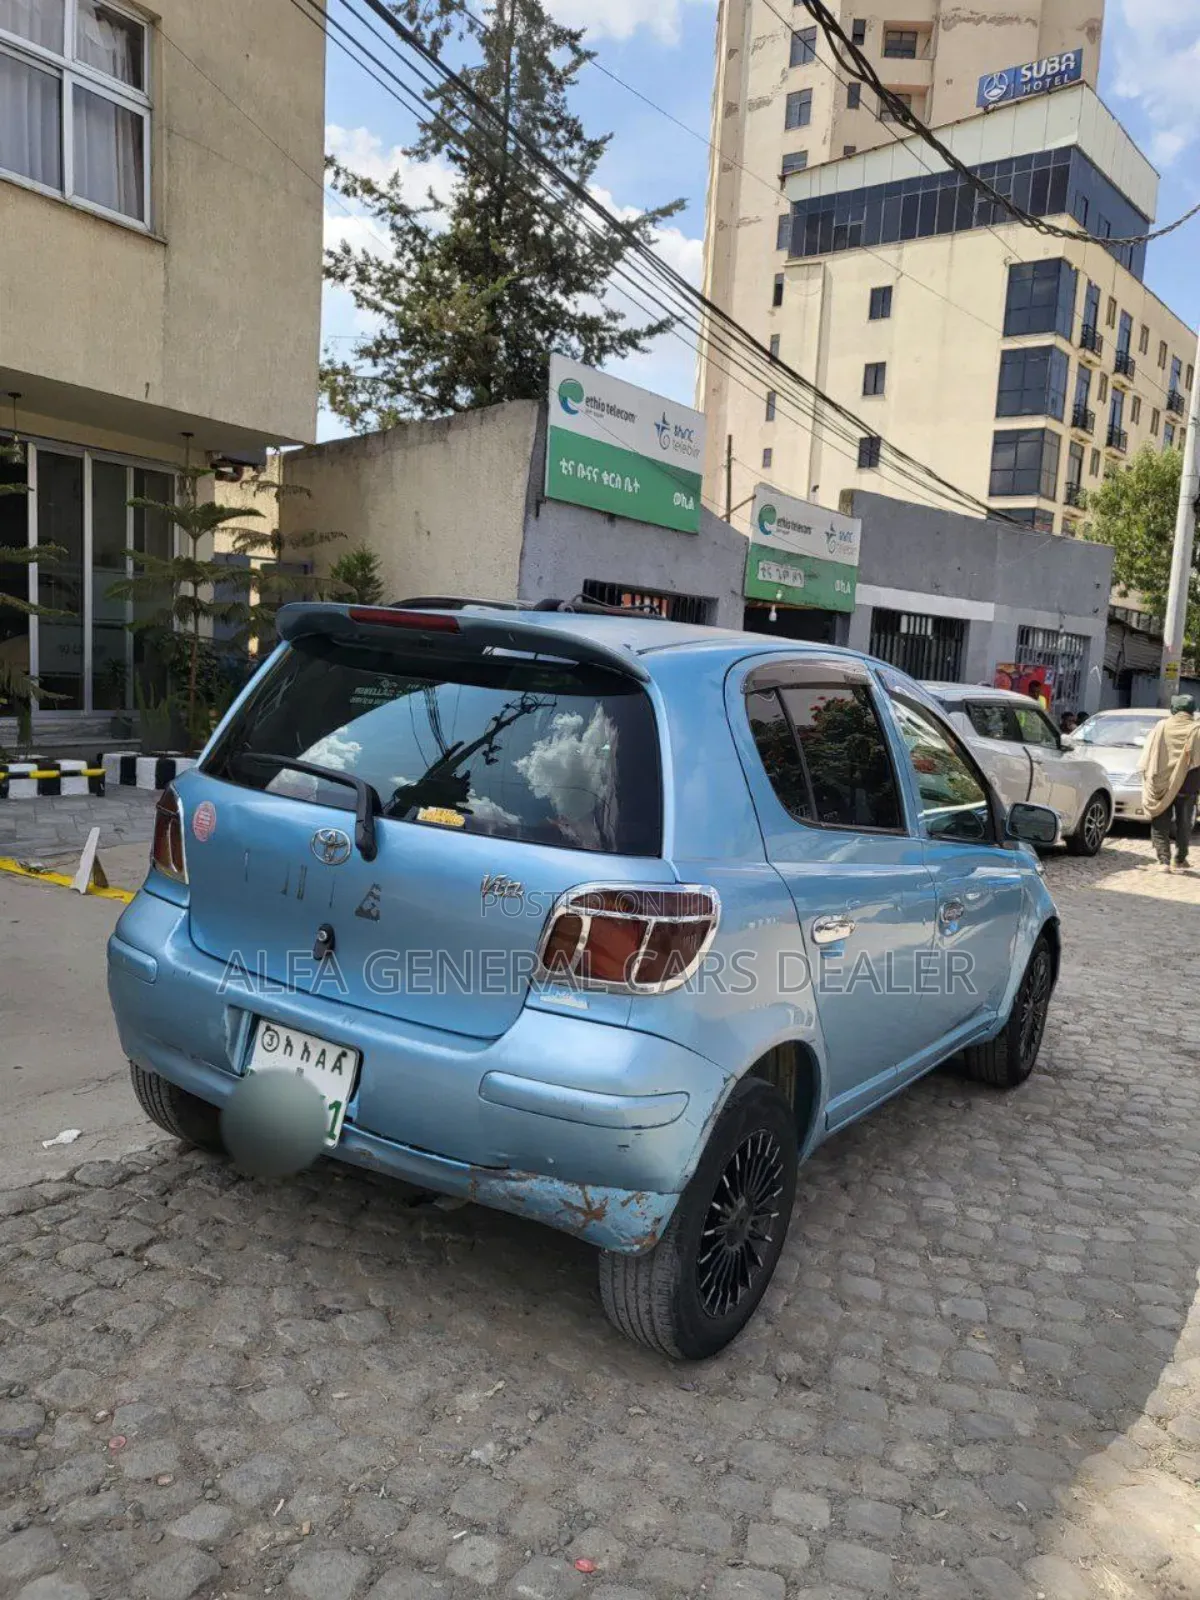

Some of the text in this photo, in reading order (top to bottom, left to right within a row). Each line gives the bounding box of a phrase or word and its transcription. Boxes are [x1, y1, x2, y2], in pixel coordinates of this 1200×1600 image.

[1020, 52, 1075, 82] SUBA
[1023, 74, 1068, 93] HOTEL
[585, 396, 605, 412] ethio
[606, 403, 636, 423] telecom
[481, 874, 525, 897] Vitz
[315, 1049, 343, 1076] AA
